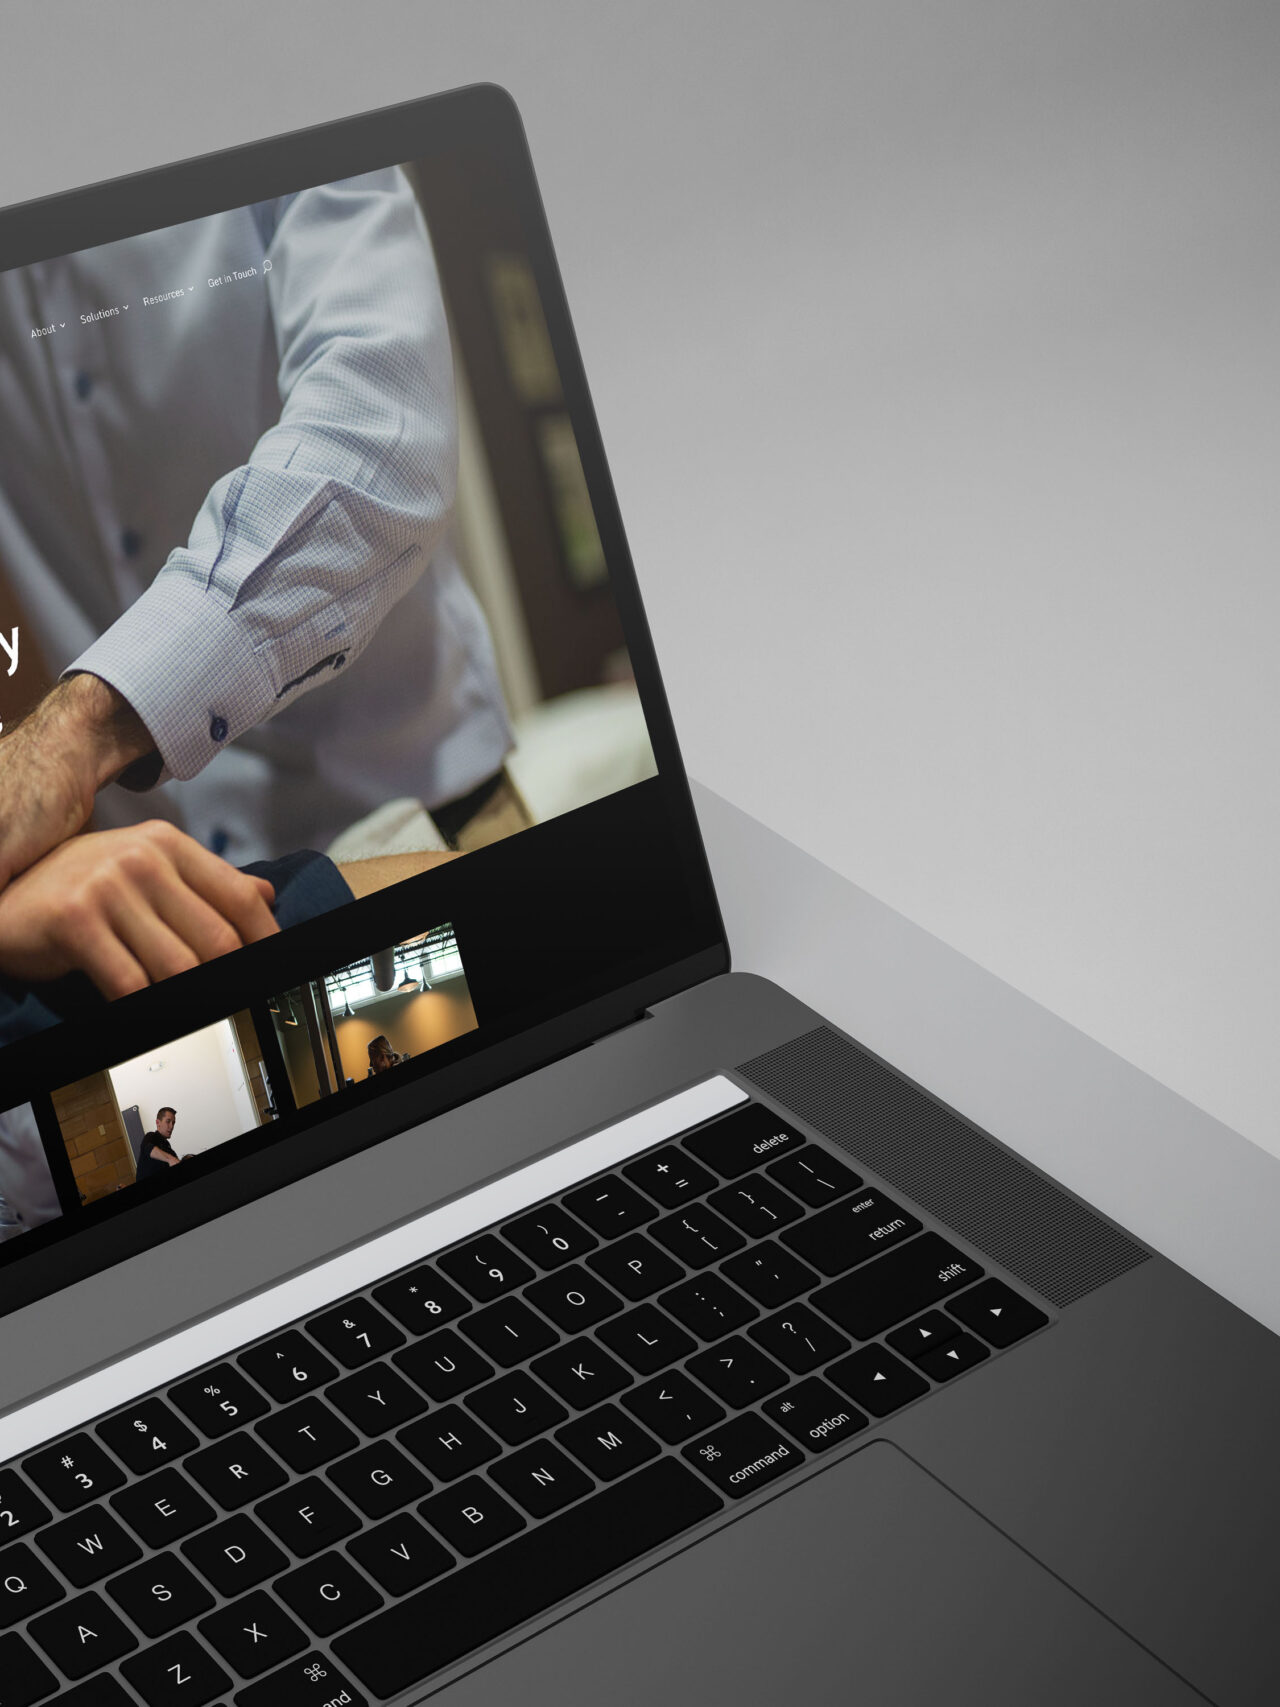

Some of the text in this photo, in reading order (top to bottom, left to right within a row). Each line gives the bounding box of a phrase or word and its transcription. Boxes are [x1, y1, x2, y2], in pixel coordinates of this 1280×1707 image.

[208, 267, 257, 288] Get in Touch
[143, 288, 185, 307] Resources
[80, 306, 120, 325] Solutions
[31, 323, 56, 339] About
[753, 1133, 789, 1154] delete
[656, 1163, 669, 1173] +
[674, 1178, 689, 1188] =
[738, 1191, 755, 1205] }
[851, 1197, 875, 1213] enter
[759, 1206, 778, 1220] ]
[536, 1224, 549, 1235] )
[682, 1219, 699, 1233] {
[868, 1219, 906, 1242] return
[551, 1237, 570, 1251] 0
[700, 1236, 719, 1250] [
[475, 1255, 487, 1265] (
[628, 1260, 642, 1274] P
[488, 1268, 504, 1282] 9
[939, 1264, 966, 1281] shift
[567, 1292, 585, 1305] O
[425, 1301, 442, 1314] 8
[342, 1319, 357, 1329] &
[781, 1322, 797, 1334] ?
[356, 1333, 371, 1347] 7
[636, 1333, 659, 1346] L
[804, 1337, 816, 1352] /
[276, 1352, 285, 1360] ^
[719, 1358, 734, 1369] >
[435, 1356, 455, 1372] U
[572, 1363, 594, 1380] K
[293, 1367, 307, 1381] 6
[203, 1384, 221, 1397] %
[368, 1390, 385, 1405] Y
[658, 1389, 673, 1400] <
[220, 1401, 238, 1416] 5
[513, 1397, 527, 1414] J
[780, 1401, 795, 1413] alt
[133, 1420, 148, 1433] $
[298, 1426, 316, 1440] T
[809, 1413, 850, 1440] option
[153, 1436, 167, 1450] 4
[439, 1432, 462, 1450] H
[597, 1432, 622, 1450] M
[60, 1455, 75, 1469] #
[729, 1444, 791, 1484] command
[229, 1464, 248, 1479] R
[371, 1470, 393, 1485] G
[532, 1468, 555, 1486] N
[75, 1474, 93, 1488] 3
[155, 1499, 176, 1516] E
[462, 1507, 483, 1523] B
[0, 1511, 19, 1526] 2
[299, 1507, 314, 1524] F
[77, 1534, 103, 1554] W
[224, 1546, 245, 1563] D
[391, 1544, 410, 1560] V
[5, 1577, 27, 1593] Q
[320, 1584, 340, 1600] C
[152, 1585, 171, 1601] S
[78, 1626, 98, 1643] A
[243, 1623, 267, 1643] X
[168, 1664, 191, 1684] Z
